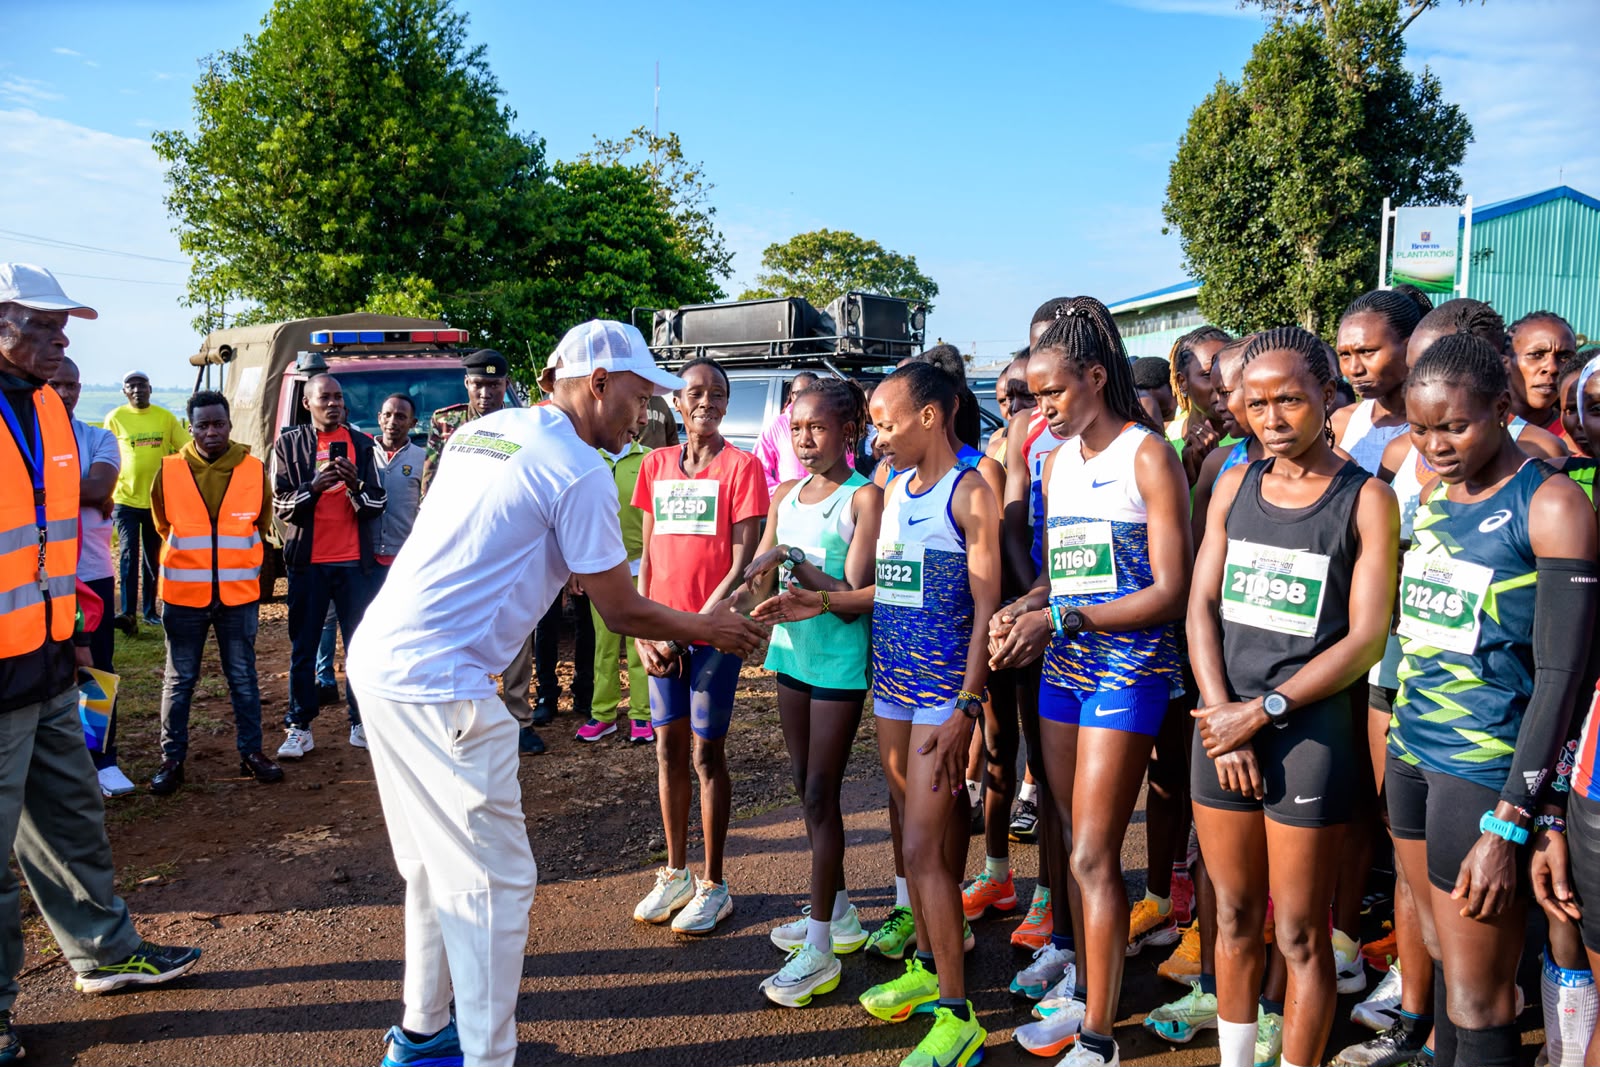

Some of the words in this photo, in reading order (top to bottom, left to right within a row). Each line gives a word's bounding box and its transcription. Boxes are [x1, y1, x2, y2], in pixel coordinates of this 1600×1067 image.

[1396, 250, 1454, 259] PLANTATIONS
[660, 499, 707, 515] 21250
[1053, 549, 1097, 571] 21160
[878, 563, 912, 583] 21322
[1231, 571, 1307, 605] 21098
[1405, 583, 1464, 617] 21249
[1551, 740, 1577, 792] +254
[1530, 768, 1548, 795] adidas
